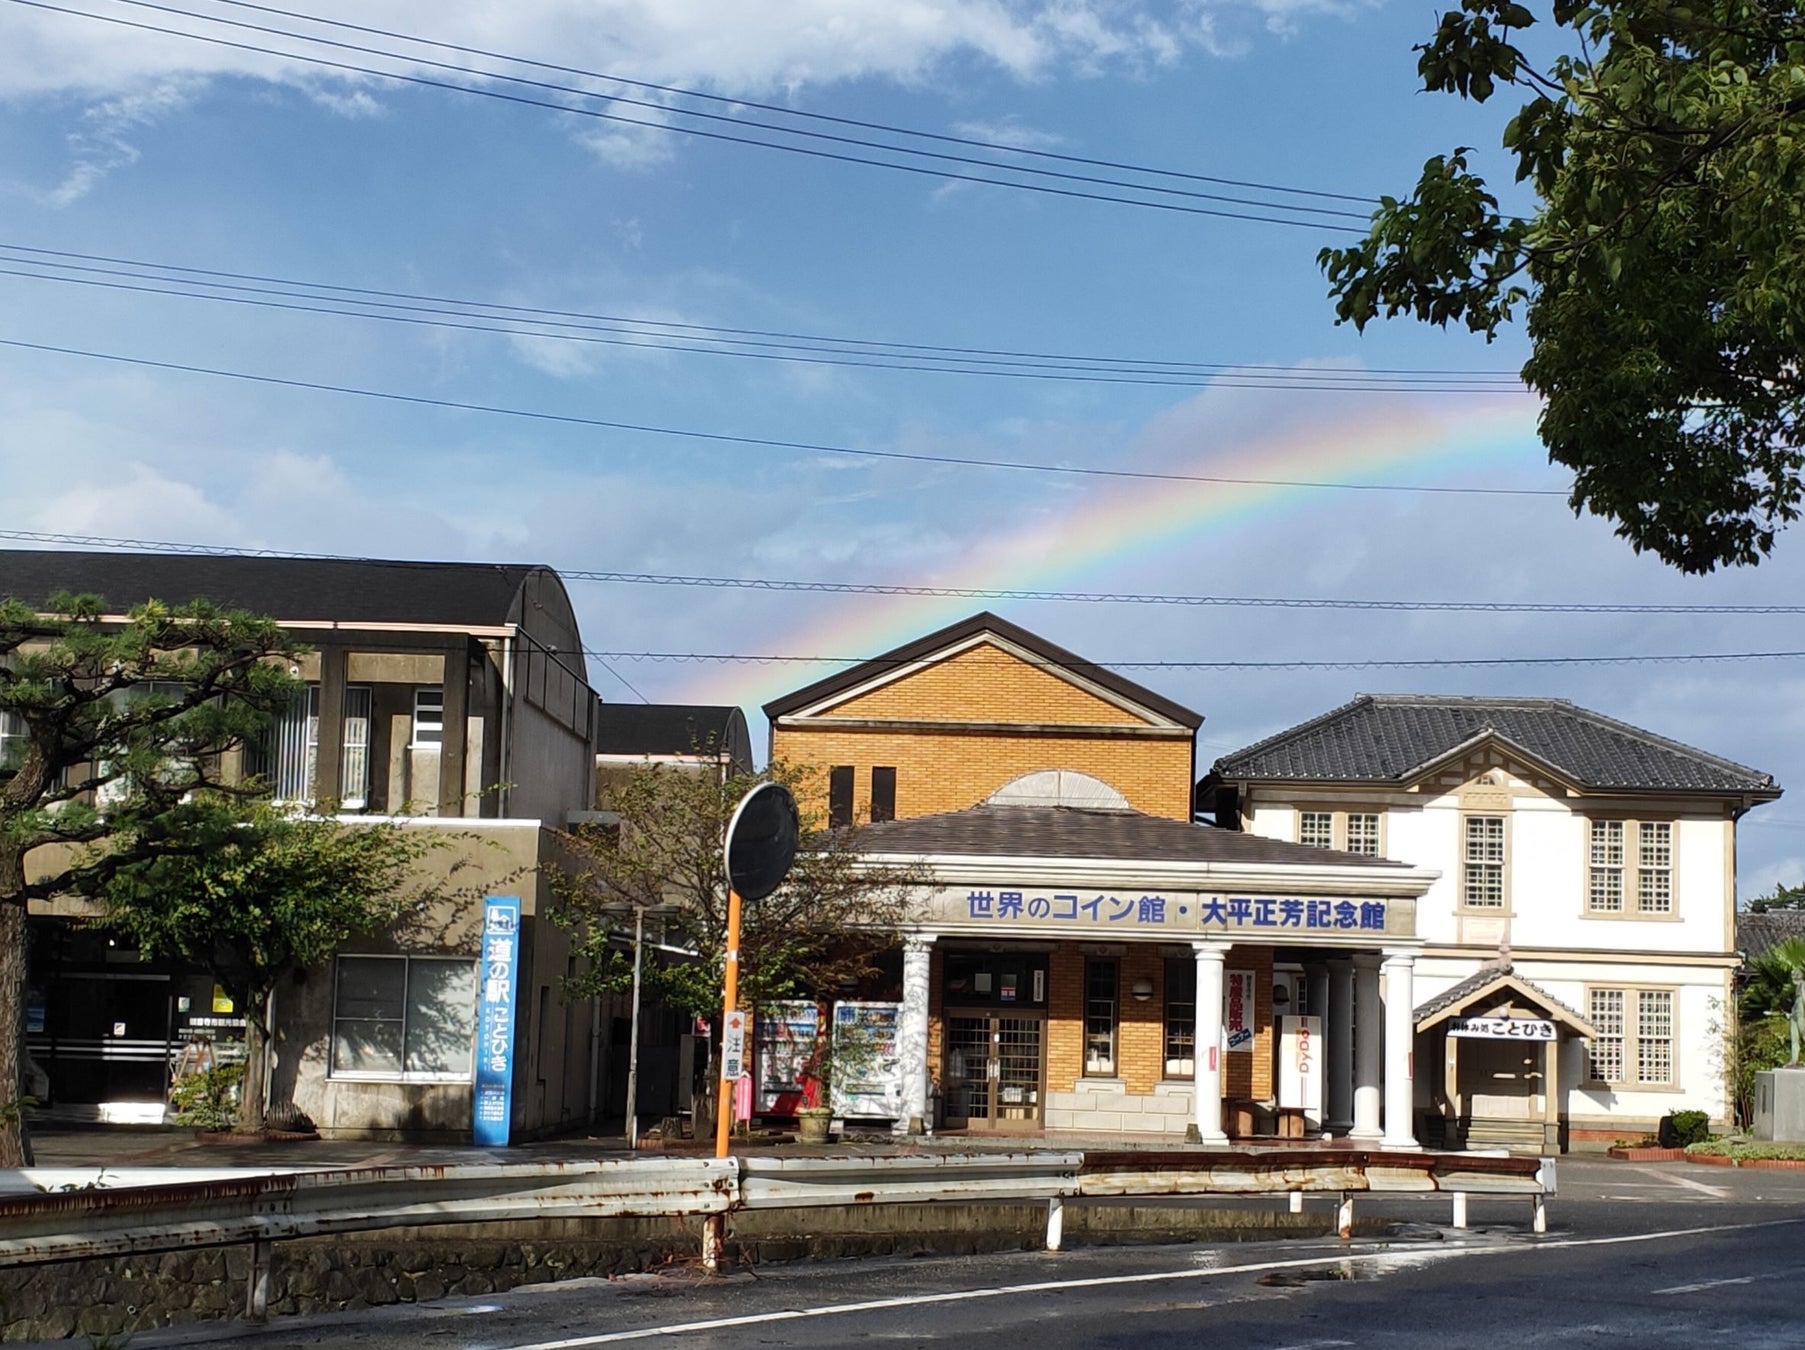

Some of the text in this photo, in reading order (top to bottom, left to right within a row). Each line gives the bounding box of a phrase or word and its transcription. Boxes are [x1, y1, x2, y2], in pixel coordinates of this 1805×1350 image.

[486, 937, 513, 1004] 道の駅
[490, 1006, 509, 1072] ことひき
[726, 1036, 740, 1077] 注意
[1299, 1029, 1313, 1074] DyDo
